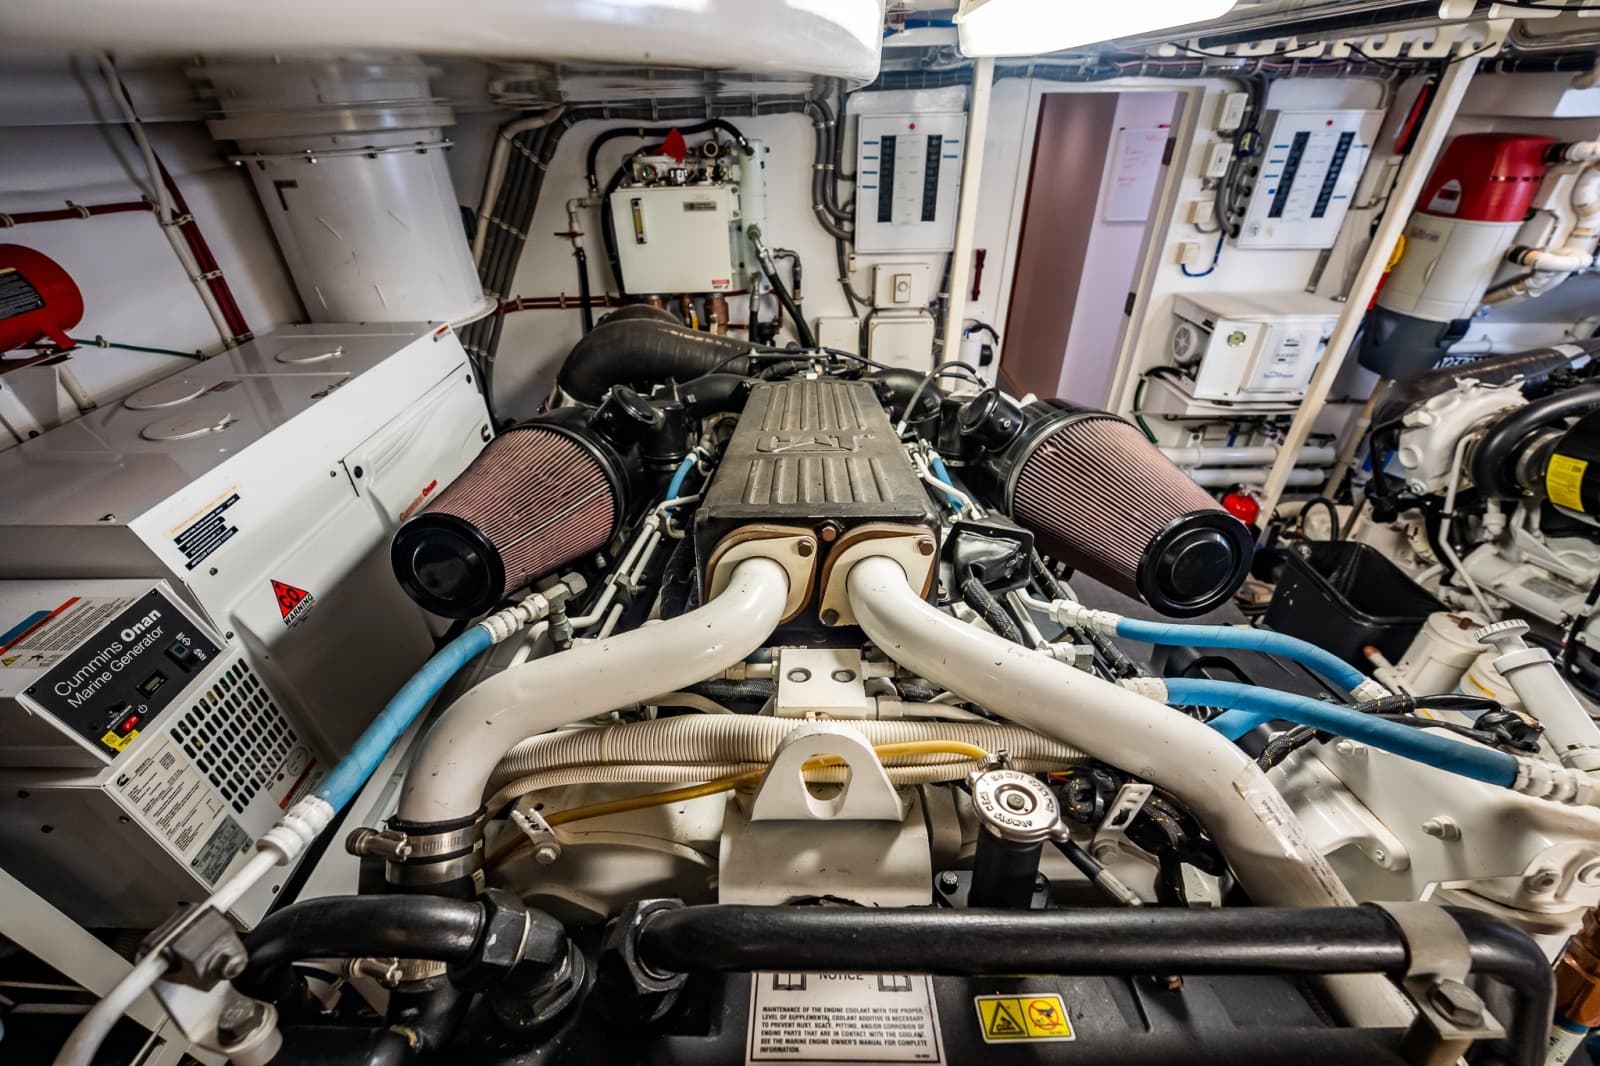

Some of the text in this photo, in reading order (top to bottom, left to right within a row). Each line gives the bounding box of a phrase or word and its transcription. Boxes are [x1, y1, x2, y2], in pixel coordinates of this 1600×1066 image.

[279, 587, 300, 609] CO
[284, 593, 314, 626] WARNING
[54, 641, 123, 696] Cummins
[120, 609, 162, 642] Onan
[67, 626, 164, 709] Marine Generator
[898, 1039, 927, 1047] COMPLETE
